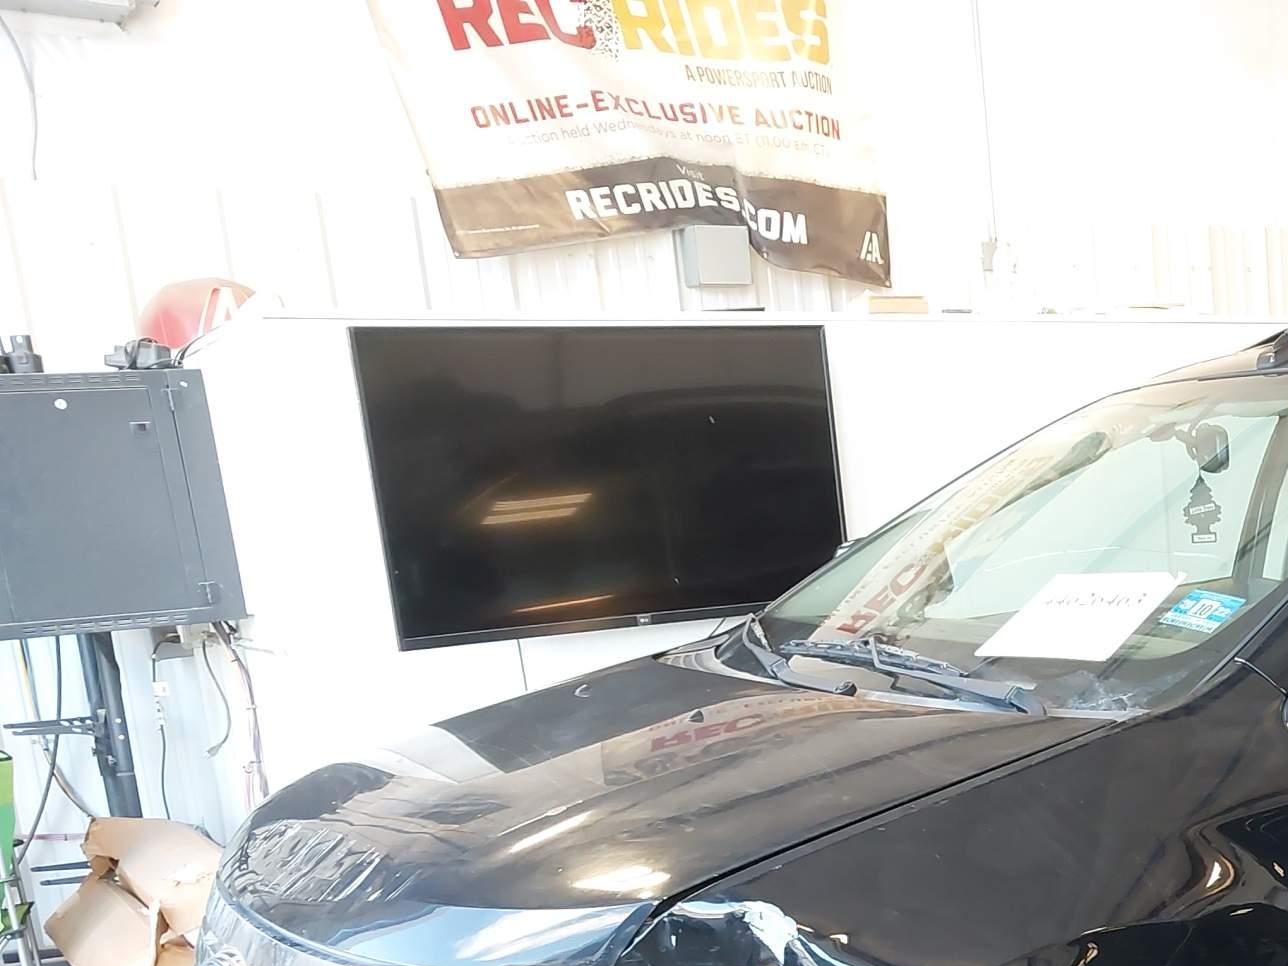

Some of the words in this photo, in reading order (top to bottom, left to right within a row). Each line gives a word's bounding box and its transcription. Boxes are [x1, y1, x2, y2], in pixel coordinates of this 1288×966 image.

[684, 64, 697, 82] A
[696, 66, 788, 90] POWERSPORT
[791, 71, 833, 95] AUCTION
[470, 90, 745, 128] ONLINE-EXCLUSIVE
[755, 108, 841, 140] AUCTION
[560, 124, 591, 142] held
[696, 133, 732, 145] noon
[565, 178, 808, 246] RECRIDES.COM
